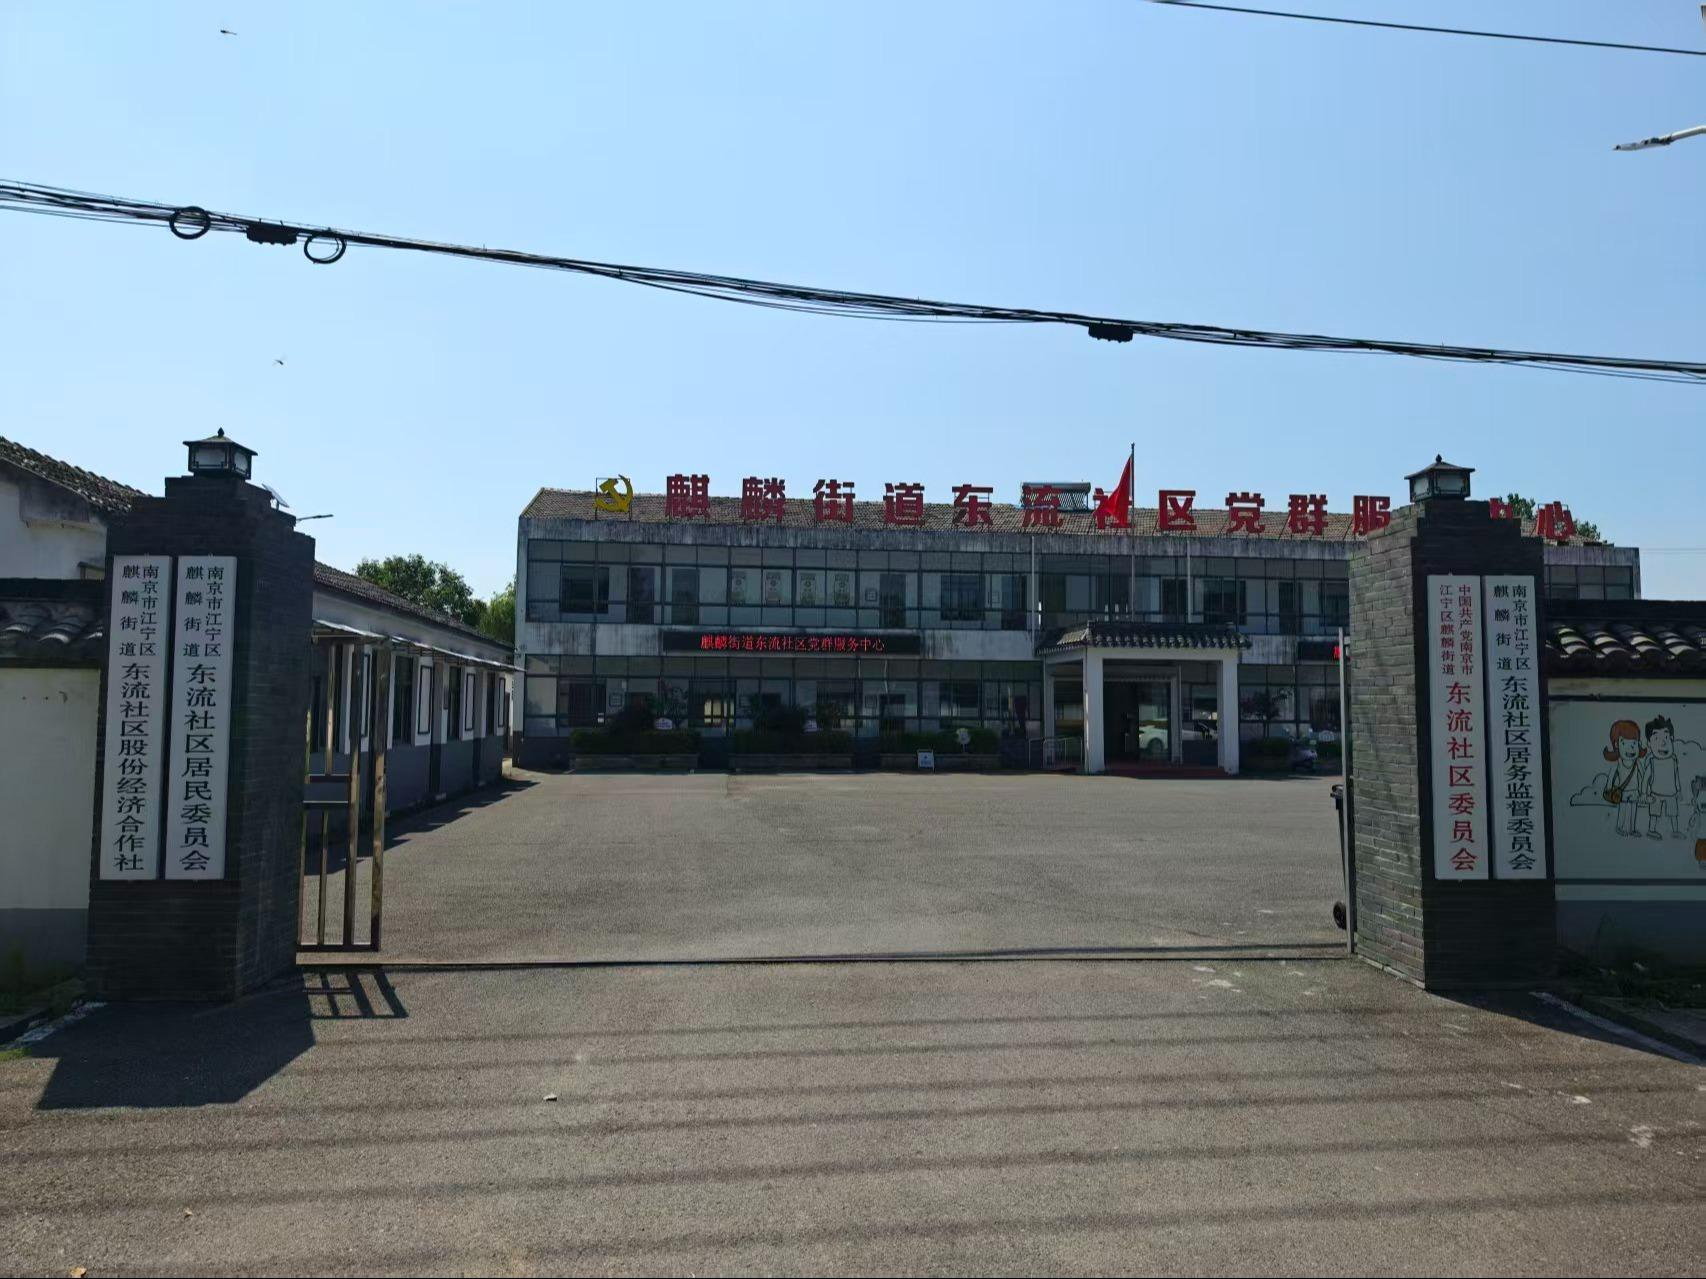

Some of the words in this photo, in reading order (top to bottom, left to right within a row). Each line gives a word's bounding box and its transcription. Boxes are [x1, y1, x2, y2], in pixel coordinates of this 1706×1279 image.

[119, 564, 140, 657] 麒麟街道
[140, 564, 160, 657] 南京市江宁区
[182, 564, 204, 657] 麒麟街道
[204, 564, 225, 657] 南京市江宁区
[700, 633, 886, 653] 麒麟街道东流社区党群服务中心
[1439, 583, 1456, 675] 江宁区麒麟街道
[1457, 583, 1474, 675] 中国共产党南京市
[1493, 583, 1513, 671] 麒麟街道
[1512, 583, 1532, 671] 南京市江宁区
[113, 662, 151, 873] 东流社区股份经济合作社
[179, 663, 217, 872] 东流社区居民委员会
[1445, 681, 1478, 872] 东流社区委员会
[1501, 675, 1536, 871] 东流社区居务监督委员会
